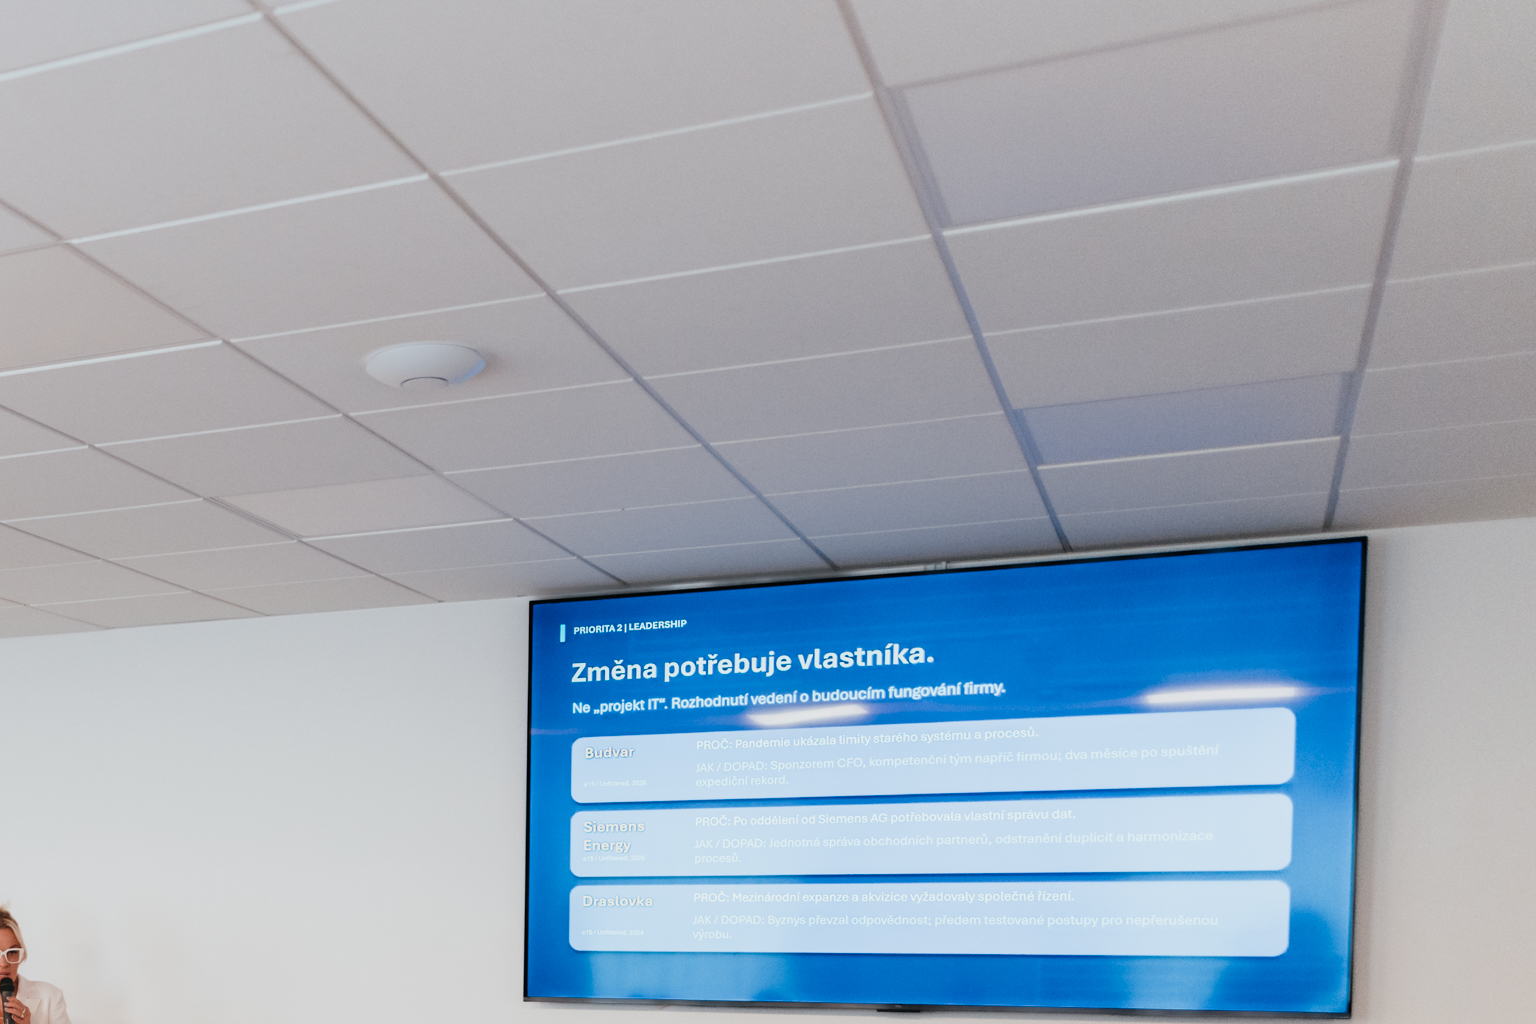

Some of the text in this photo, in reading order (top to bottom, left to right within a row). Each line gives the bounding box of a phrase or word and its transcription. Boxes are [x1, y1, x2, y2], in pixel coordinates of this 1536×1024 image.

[574, 624, 615, 634] PRIORITA
[629, 619, 687, 631] LEADERSHIP
[571, 643, 934, 683] Změna potřebuje vlastníka.
[573, 679, 1006, 715] Ne „projekt IT“. Rozhodnutí vedení o budoucím fungování firmy.
[697, 737, 732, 750] PROČ:
[735, 737, 790, 748] Pandemie
[793, 735, 836, 746] ukázala
[839, 734, 871, 746] limity
[874, 732, 918, 743] starého
[921, 730, 971, 744] systému
[985, 726, 1038, 741] procesů.
[585, 745, 635, 760] Budvar
[696, 762, 714, 772] JAK
[724, 760, 767, 771] DOPAD:
[771, 758, 834, 772] Sponzorem
[837, 757, 866, 769] CFO,
[870, 754, 947, 768] kompetenční
[949, 753, 971, 766] tým
[975, 751, 1013, 765] napříč
[1016, 750, 1061, 762] firmou;
[1065, 750, 1087, 760] dva
[1091, 747, 1138, 759] měsíce
[1141, 749, 1157, 759] po
[1161, 744, 1219, 758] spuštění
[696, 775, 789, 789] expediční rekord.
[696, 809, 1076, 826] PROČ: Po oddělení od Siemens AG potřebovala vlastní správu dat.
[584, 820, 645, 834] Siemens
[584, 839, 632, 854] Energy
[694, 839, 713, 848] JAK
[723, 838, 766, 848] DOPAD:
[769, 837, 820, 847] Jednotná
[823, 836, 860, 848] správa
[863, 835, 933, 846] obchodních
[937, 833, 992, 847] partnerů,
[996, 833, 1062, 844] odstranění
[1065, 832, 1113, 845] duplicit
[1117, 834, 1124, 842] a
[1127, 831, 1213, 841] harmonizace
[695, 852, 741, 865] procesů.
[583, 894, 654, 908] Draslovka
[694, 890, 1074, 904] PROČ: Mezinárodní expanze a akvizice vyžadovaly společné řízení.
[693, 915, 711, 924] JAK
[721, 915, 764, 924] DOPAD:
[768, 915, 805, 926] Byznys
[809, 915, 849, 926] převzal
[852, 915, 931, 927] odpovědnost;
[935, 915, 981, 927] předem
[984, 915, 1044, 925] testované
[1048, 916, 1098, 927] postupy
[1102, 917, 1122, 927] pro
[1126, 915, 1218, 927] nepřerušenou
[693, 929, 732, 940] výrobu.
